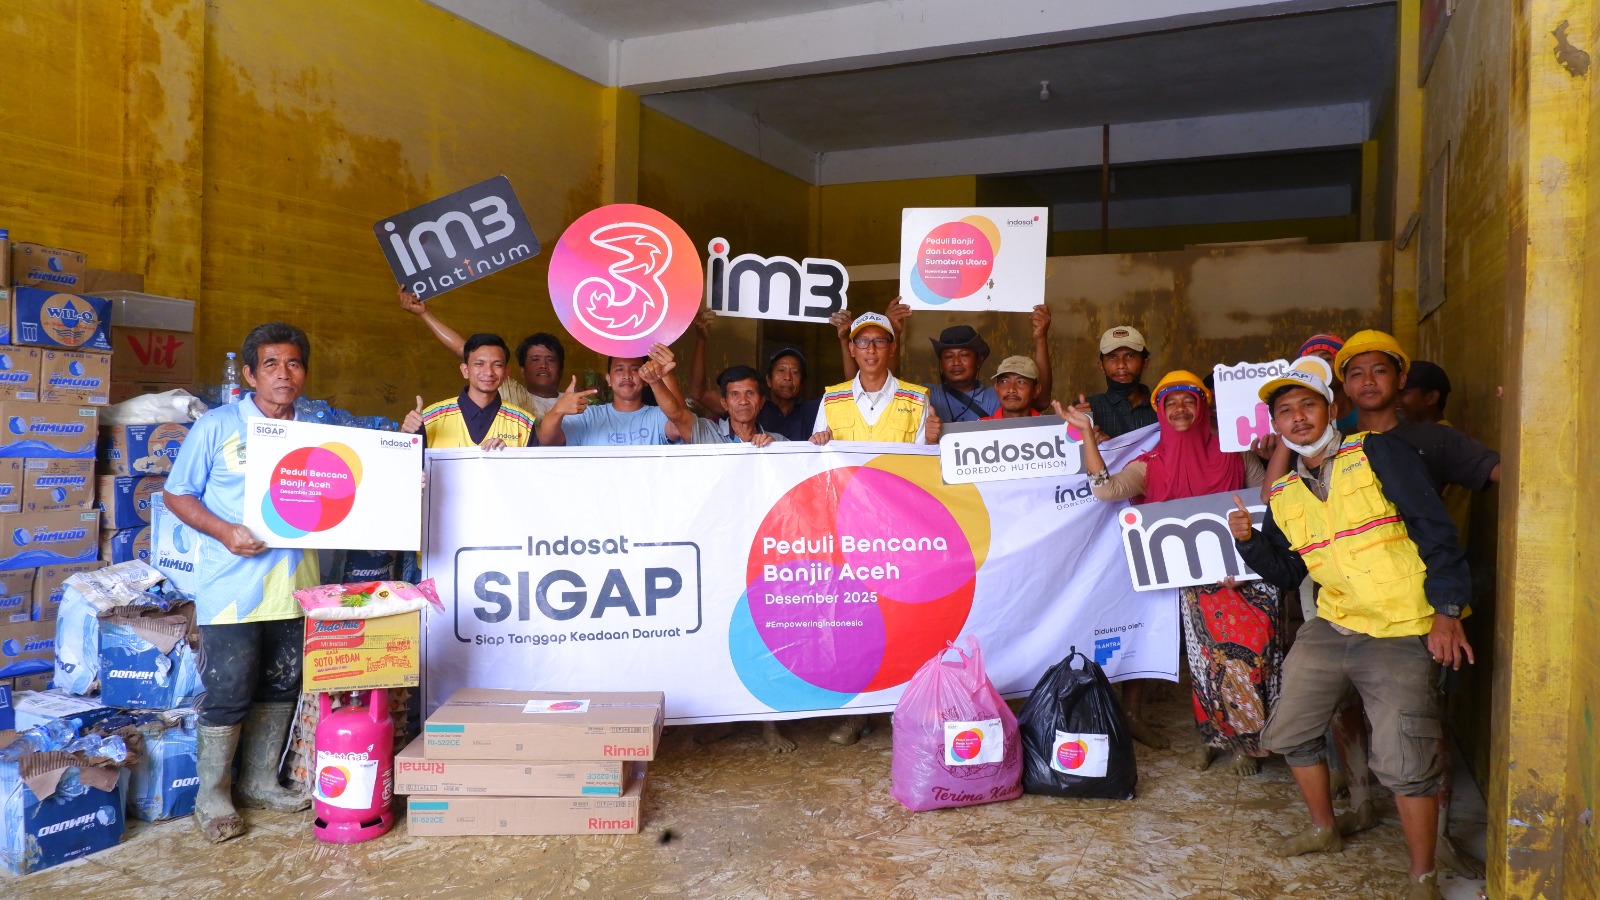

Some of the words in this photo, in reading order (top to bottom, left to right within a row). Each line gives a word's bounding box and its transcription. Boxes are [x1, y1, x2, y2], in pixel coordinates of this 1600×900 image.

[384, 195, 516, 277] im3
[926, 237, 950, 245] Peduli
[951, 237, 975, 246] Banjir
[942, 248, 975, 257] Longsor
[965, 258, 988, 266] Utara
[412, 243, 530, 298] platinum
[712, 242, 844, 318] im3
[127, 329, 185, 369] Vit
[1218, 363, 1286, 382] indosat
[256, 426, 285, 436] SIGAP
[380, 437, 412, 448] indosat
[954, 435, 1067, 466] indosat
[280, 467, 308, 477] Peduli
[309, 469, 348, 480] Bencana
[956, 464, 1006, 476] OOREDOO
[1011, 460, 1067, 472] HUTCHISON
[280, 478, 307, 489] Banjir
[307, 480, 331, 489] Aceh
[527, 535, 629, 556] Indosat
[763, 535, 834, 555] Peduli
[841, 535, 948, 553] Bencana
[1124, 511, 1266, 587] im
[763, 563, 832, 586] Banjir
[838, 561, 900, 581] Aceh
[473, 566, 683, 624] SIGAP
[765, 592, 839, 605] Desember
[843, 591, 878, 604] 2025
[765, 620, 864, 629] #EmpoweringIndonesia
[1094, 625, 1127, 636] Didukung
[475, 634, 505, 647] Siap
[508, 632, 567, 646] Tanggap
[570, 630, 629, 642] Keadaan
[632, 627, 681, 639] Darurat
[313, 656, 334, 667] SOTO
[335, 653, 360, 664] MEDAN
[603, 744, 650, 757] Rinnai
[399, 761, 445, 774] Rinnai
[931, 786, 985, 802] Terima
[588, 816, 635, 830] Rinnai
